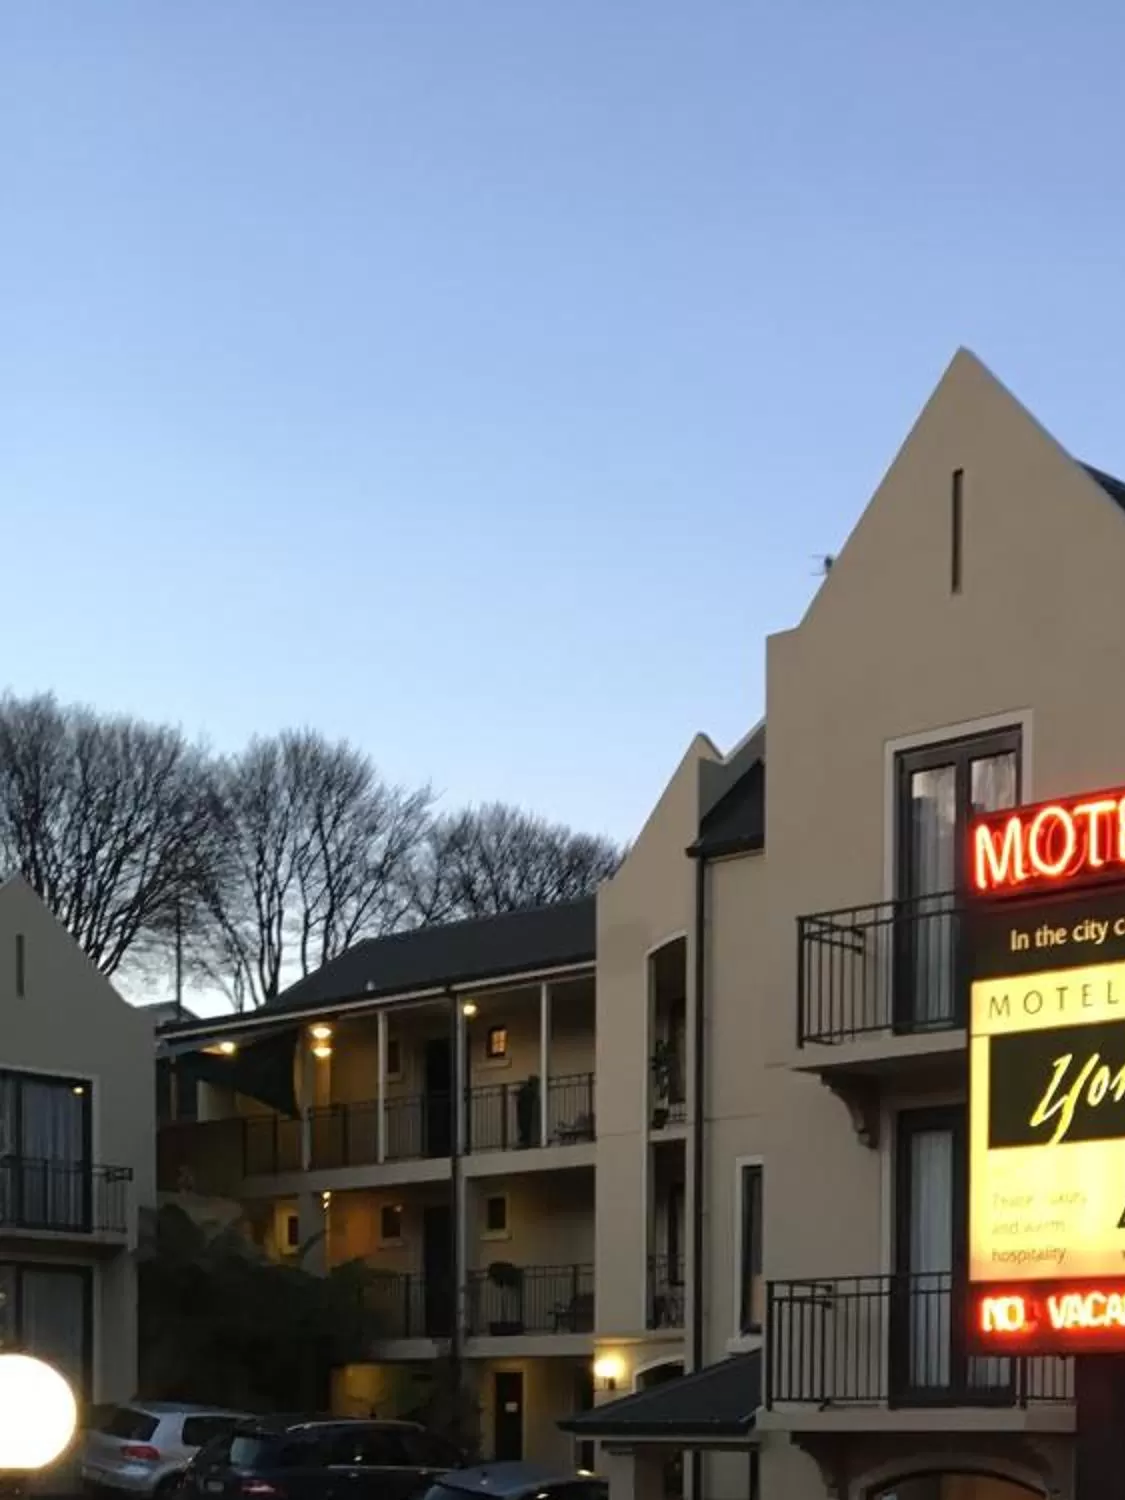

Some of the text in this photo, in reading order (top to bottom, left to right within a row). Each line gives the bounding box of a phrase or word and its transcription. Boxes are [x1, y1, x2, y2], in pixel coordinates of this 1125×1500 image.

[1010, 929, 1029, 951] In
[1035, 924, 1066, 948] the
[1072, 918, 1109, 944] city
[988, 980, 1119, 1019] MOTEL
[981, 1296, 1026, 1332] NO
